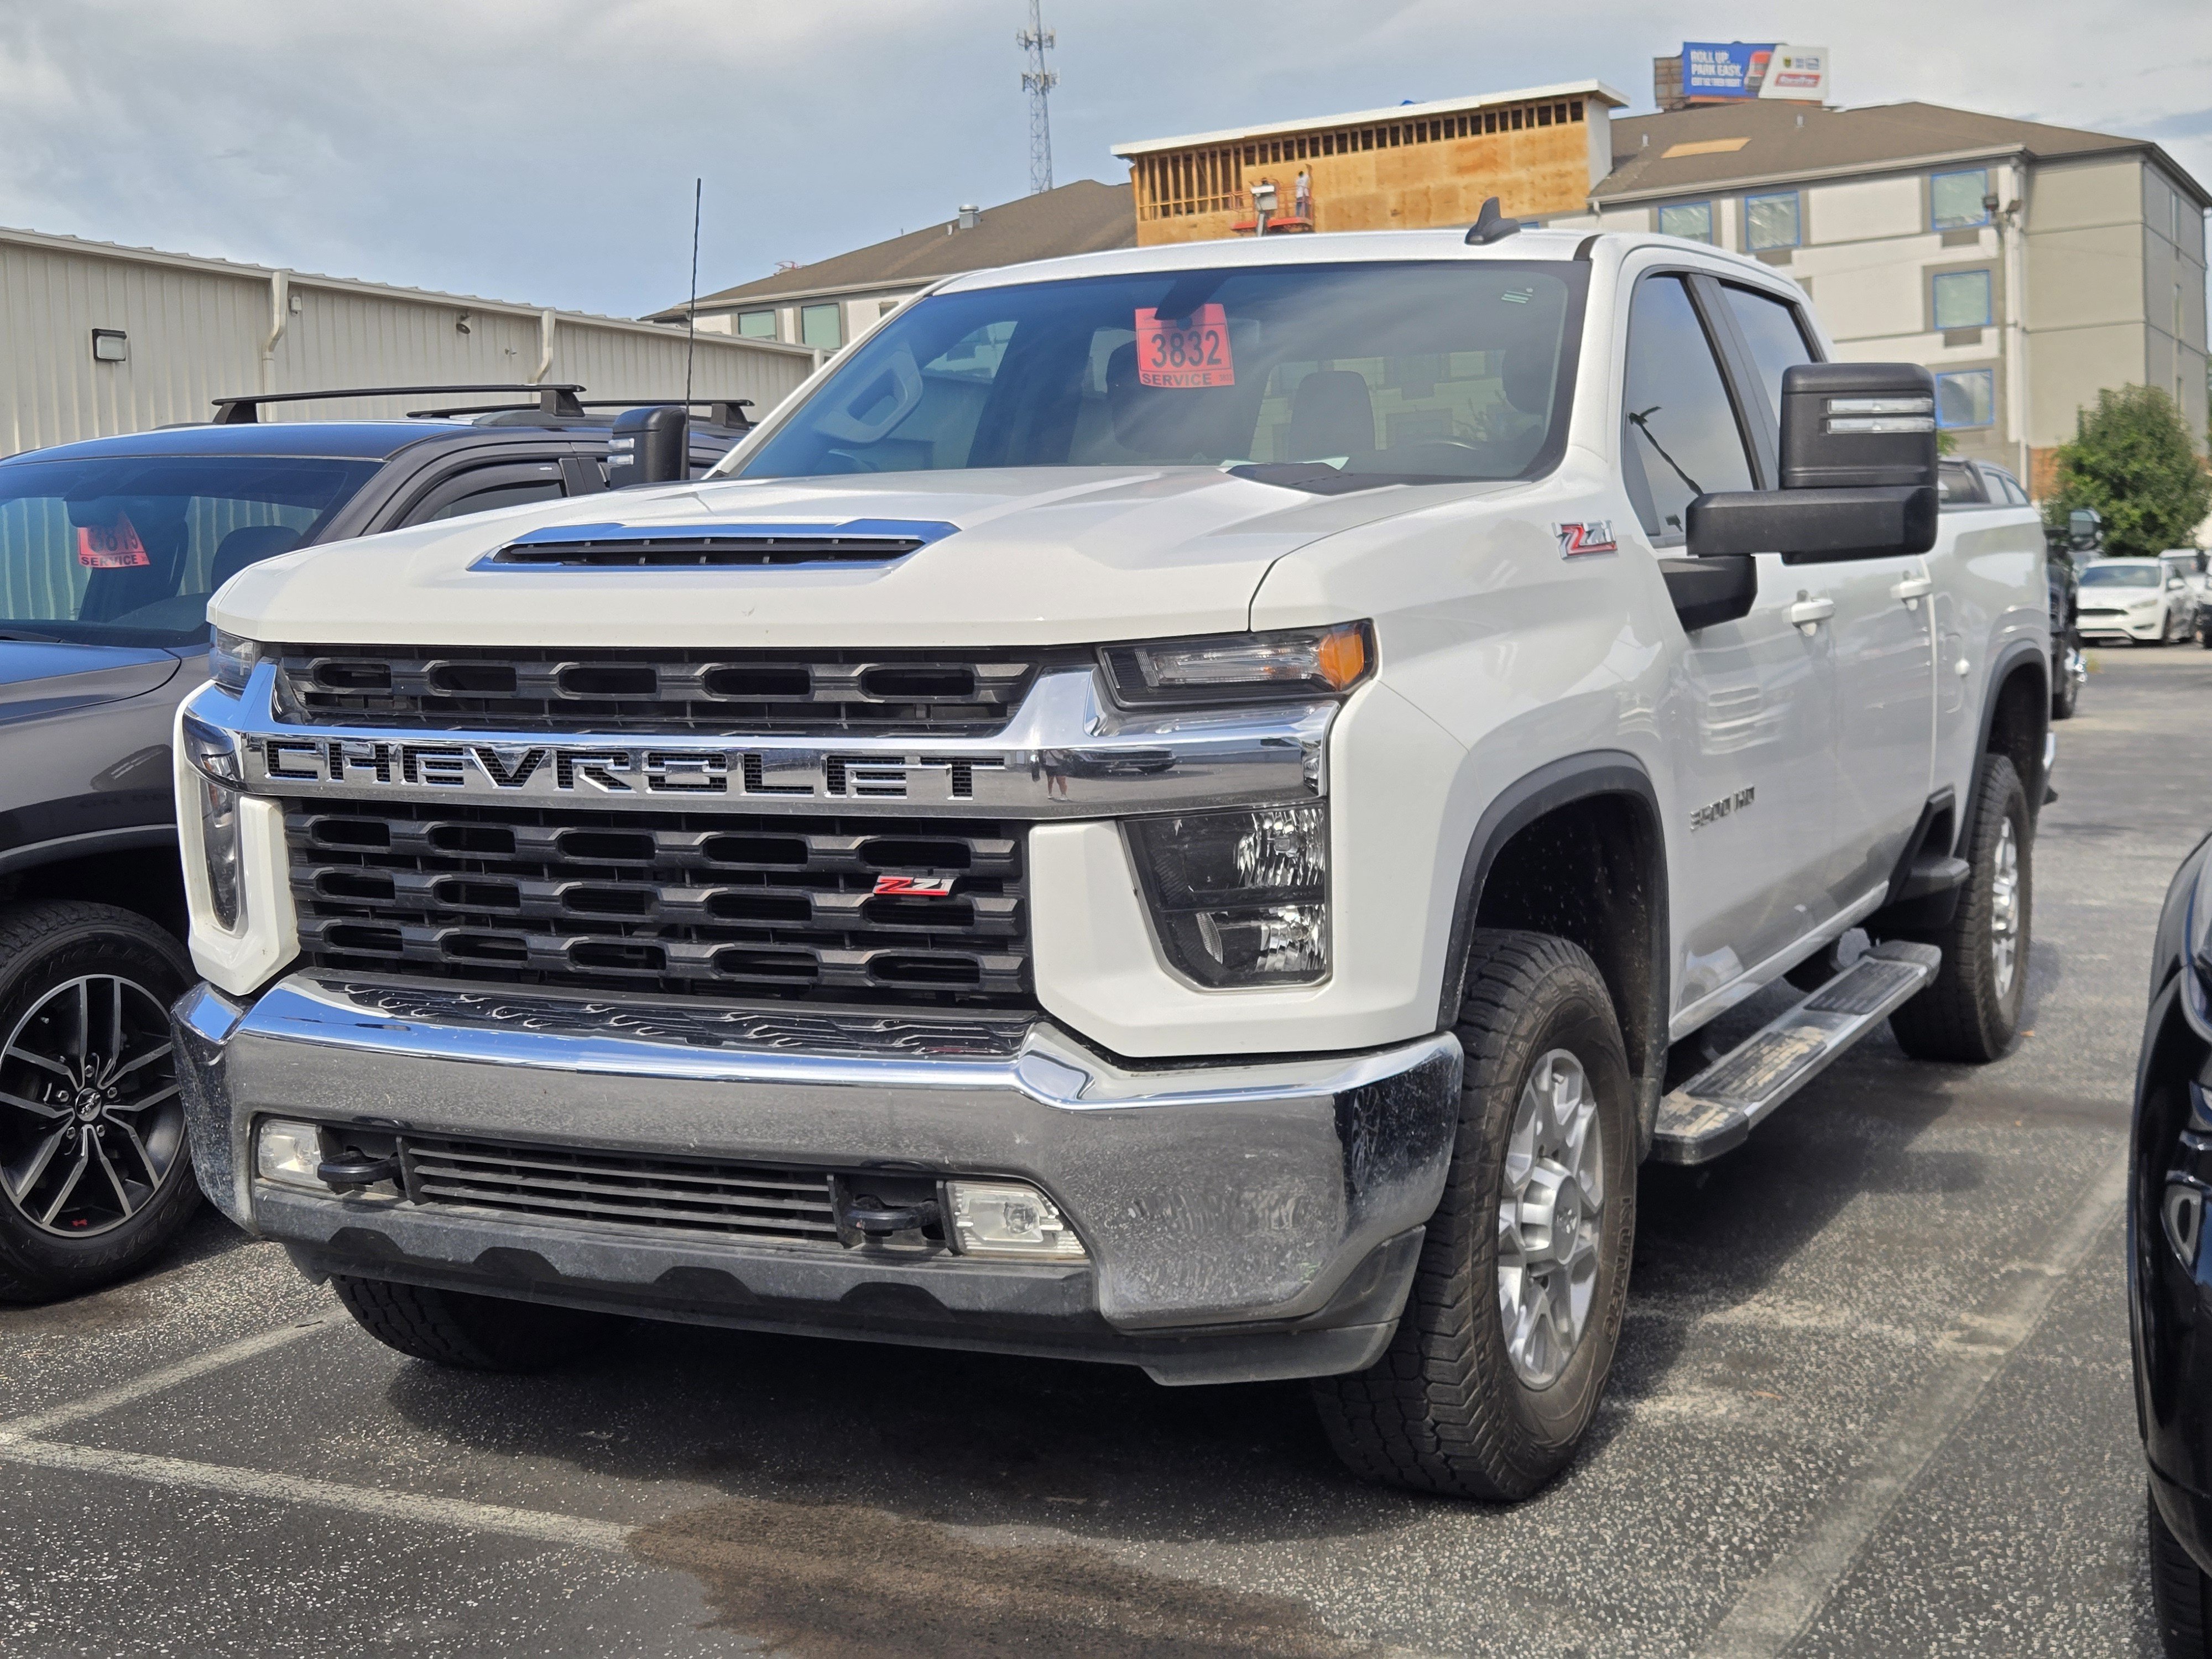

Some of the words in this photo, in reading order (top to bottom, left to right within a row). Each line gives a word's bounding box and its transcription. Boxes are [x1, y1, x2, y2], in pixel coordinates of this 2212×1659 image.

[1151, 330, 1222, 368] 3832
[1142, 373, 1212, 385] SERVICE
[81, 555, 138, 566] SERVICE
[264, 740, 1005, 800] CHEVROLET
[1733, 785, 1755, 812] HD
[872, 875, 956, 896] Z71
